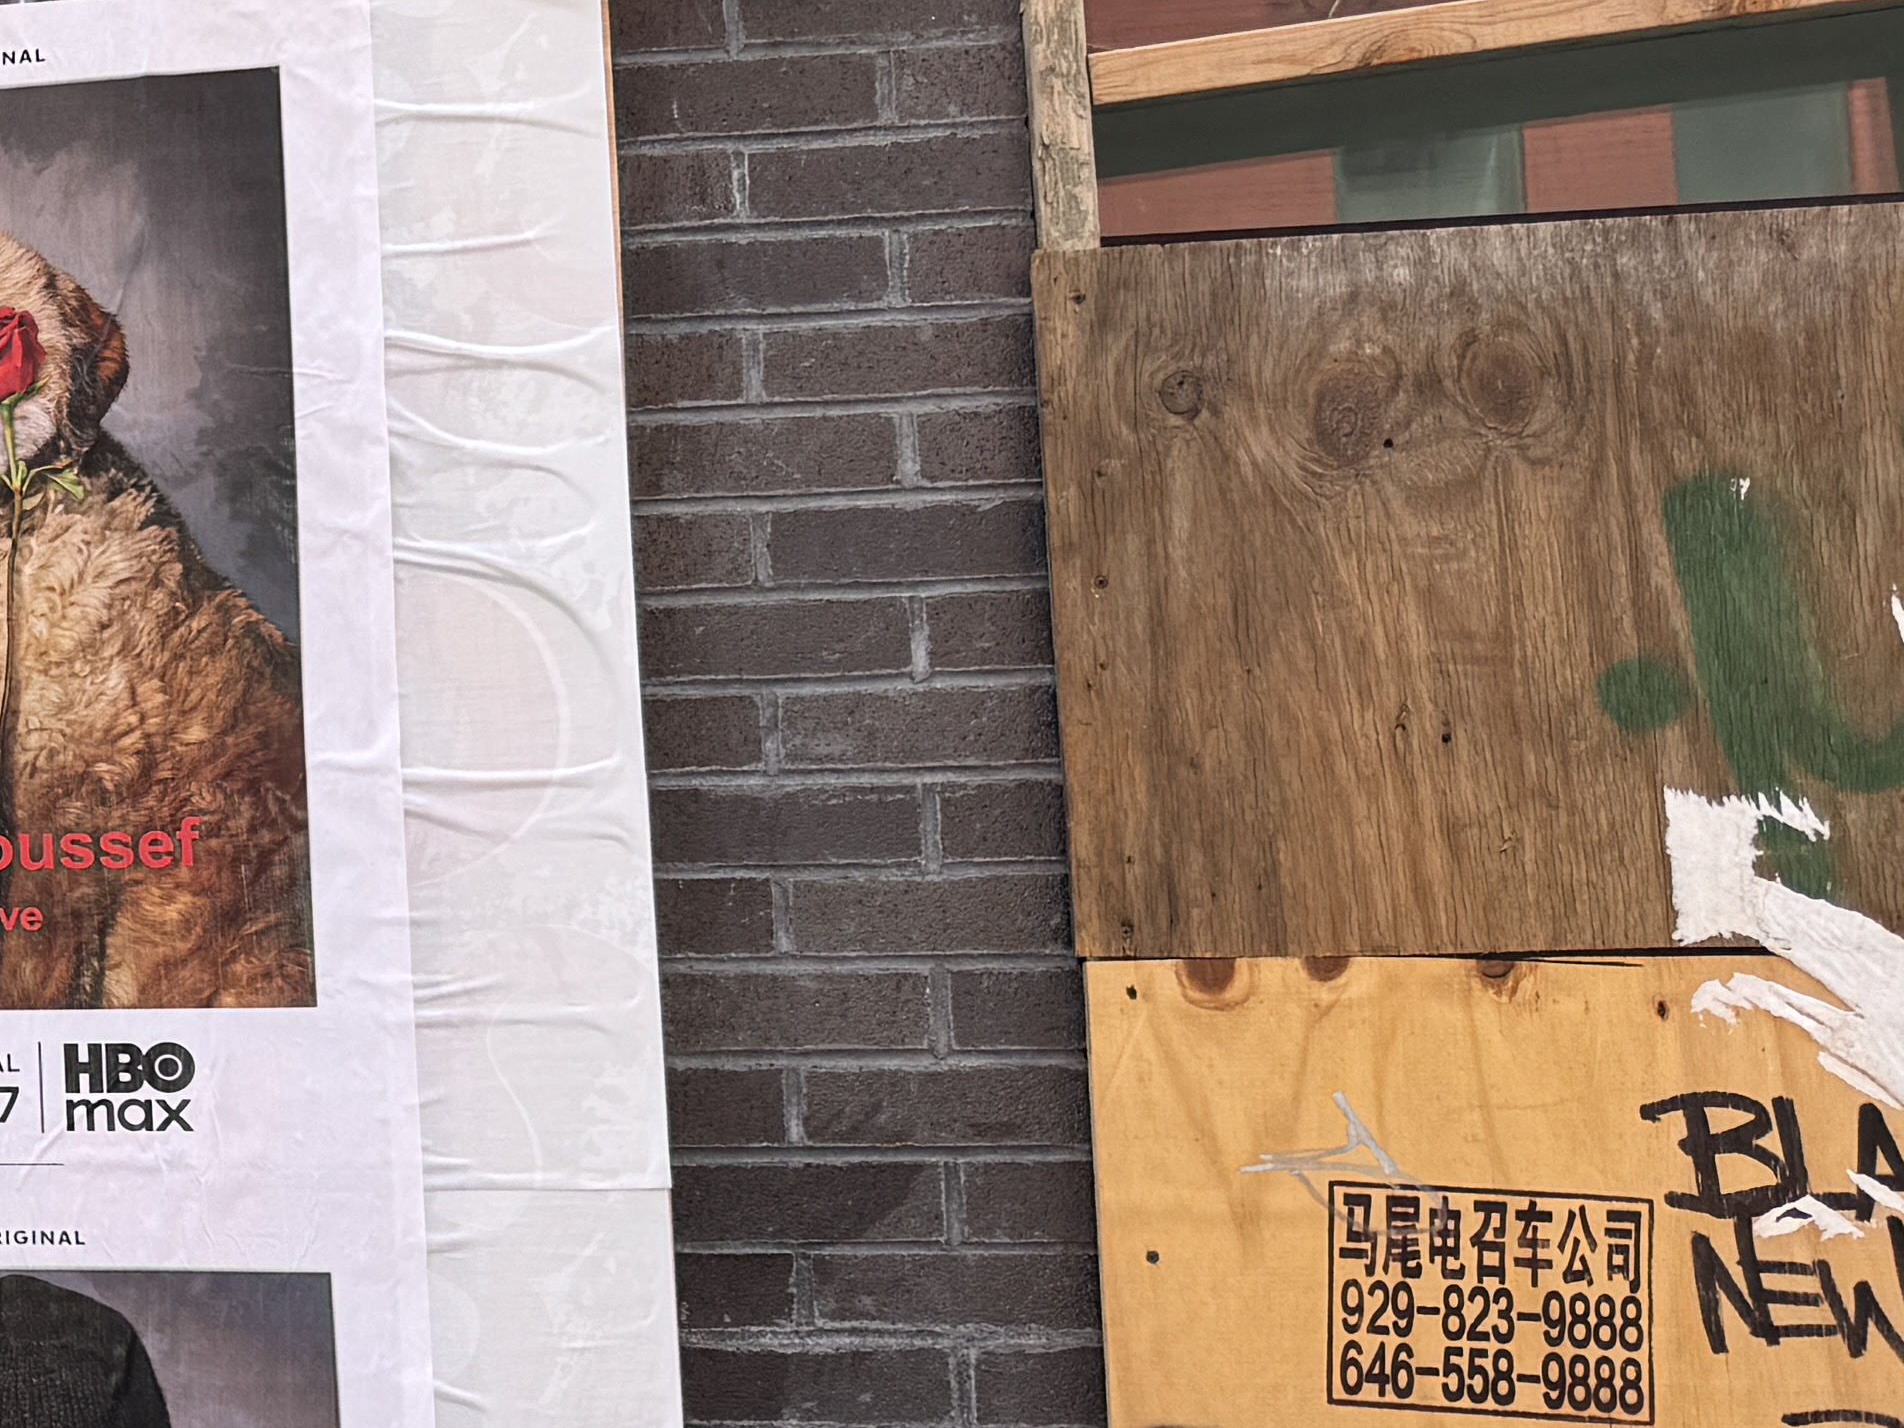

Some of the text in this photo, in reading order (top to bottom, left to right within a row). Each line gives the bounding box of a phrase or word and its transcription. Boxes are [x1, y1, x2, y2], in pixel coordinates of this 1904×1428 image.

[64, 1042, 195, 1093] HBO
[66, 1099, 193, 1131] max
[1339, 1192, 1641, 1293] 马尾电召车公司
[1342, 1279, 1643, 1351] 929-823-9888
[1342, 1340, 1644, 1414] 646-558-9888
